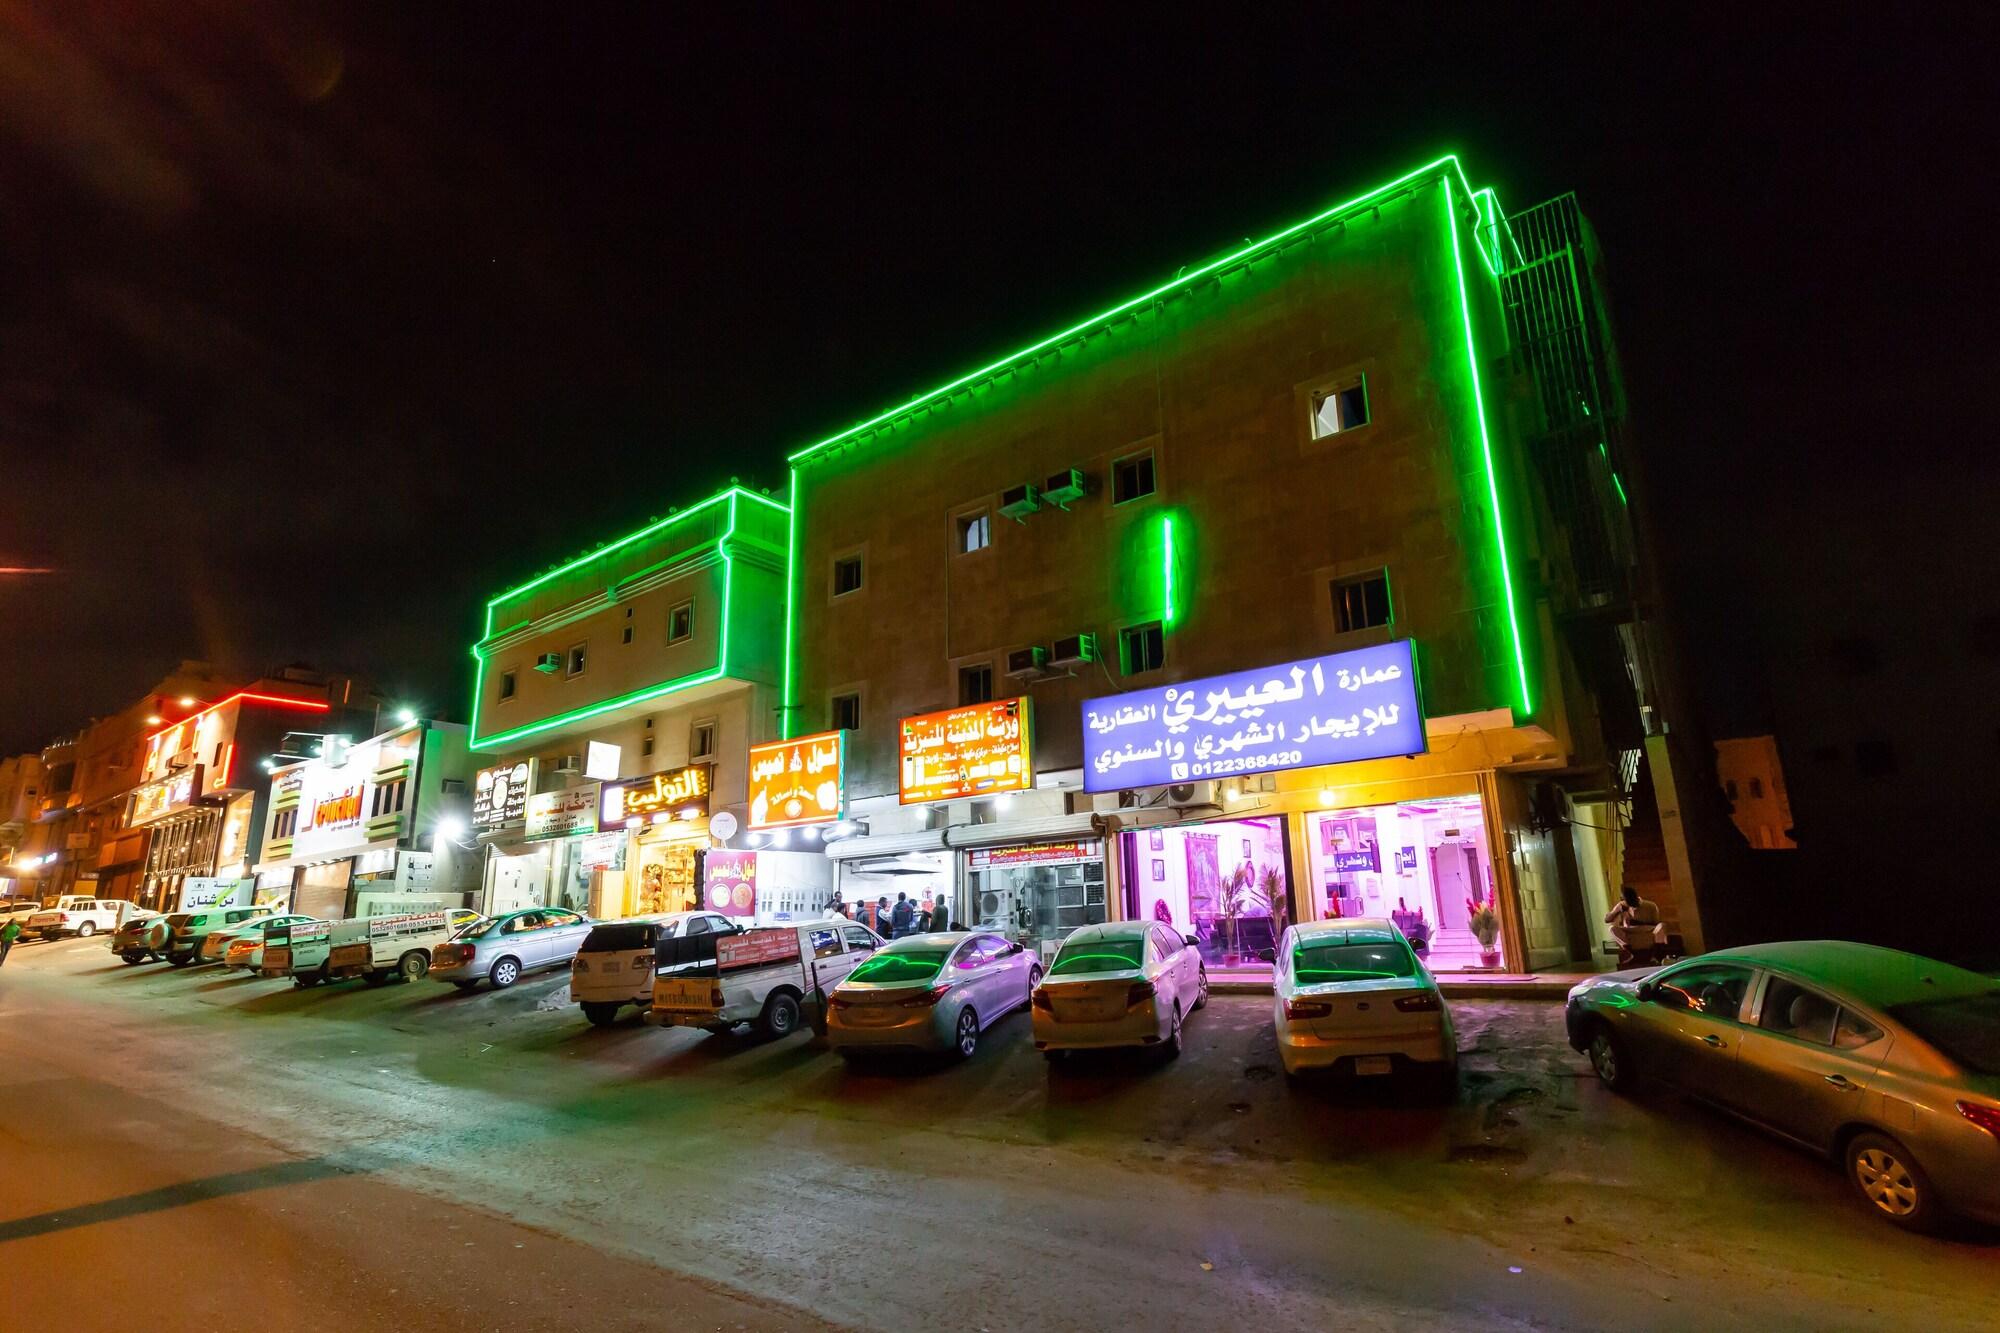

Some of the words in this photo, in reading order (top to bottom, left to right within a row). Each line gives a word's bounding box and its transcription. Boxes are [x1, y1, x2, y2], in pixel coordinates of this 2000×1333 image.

[1337, 665, 1402, 690] عمارة
[947, 719, 985, 748] المدينة
[987, 710, 1019, 739] ورشة
[1088, 704, 1157, 734] العقارية
[904, 724, 945, 755] للتبريد
[1194, 722, 1285, 759] الشهري
[807, 740, 837, 774] فول
[1094, 738, 1186, 773] والسنوي
[1192, 750, 1302, 777] 0122368420
[1336, 854, 1367, 871] وشهري
